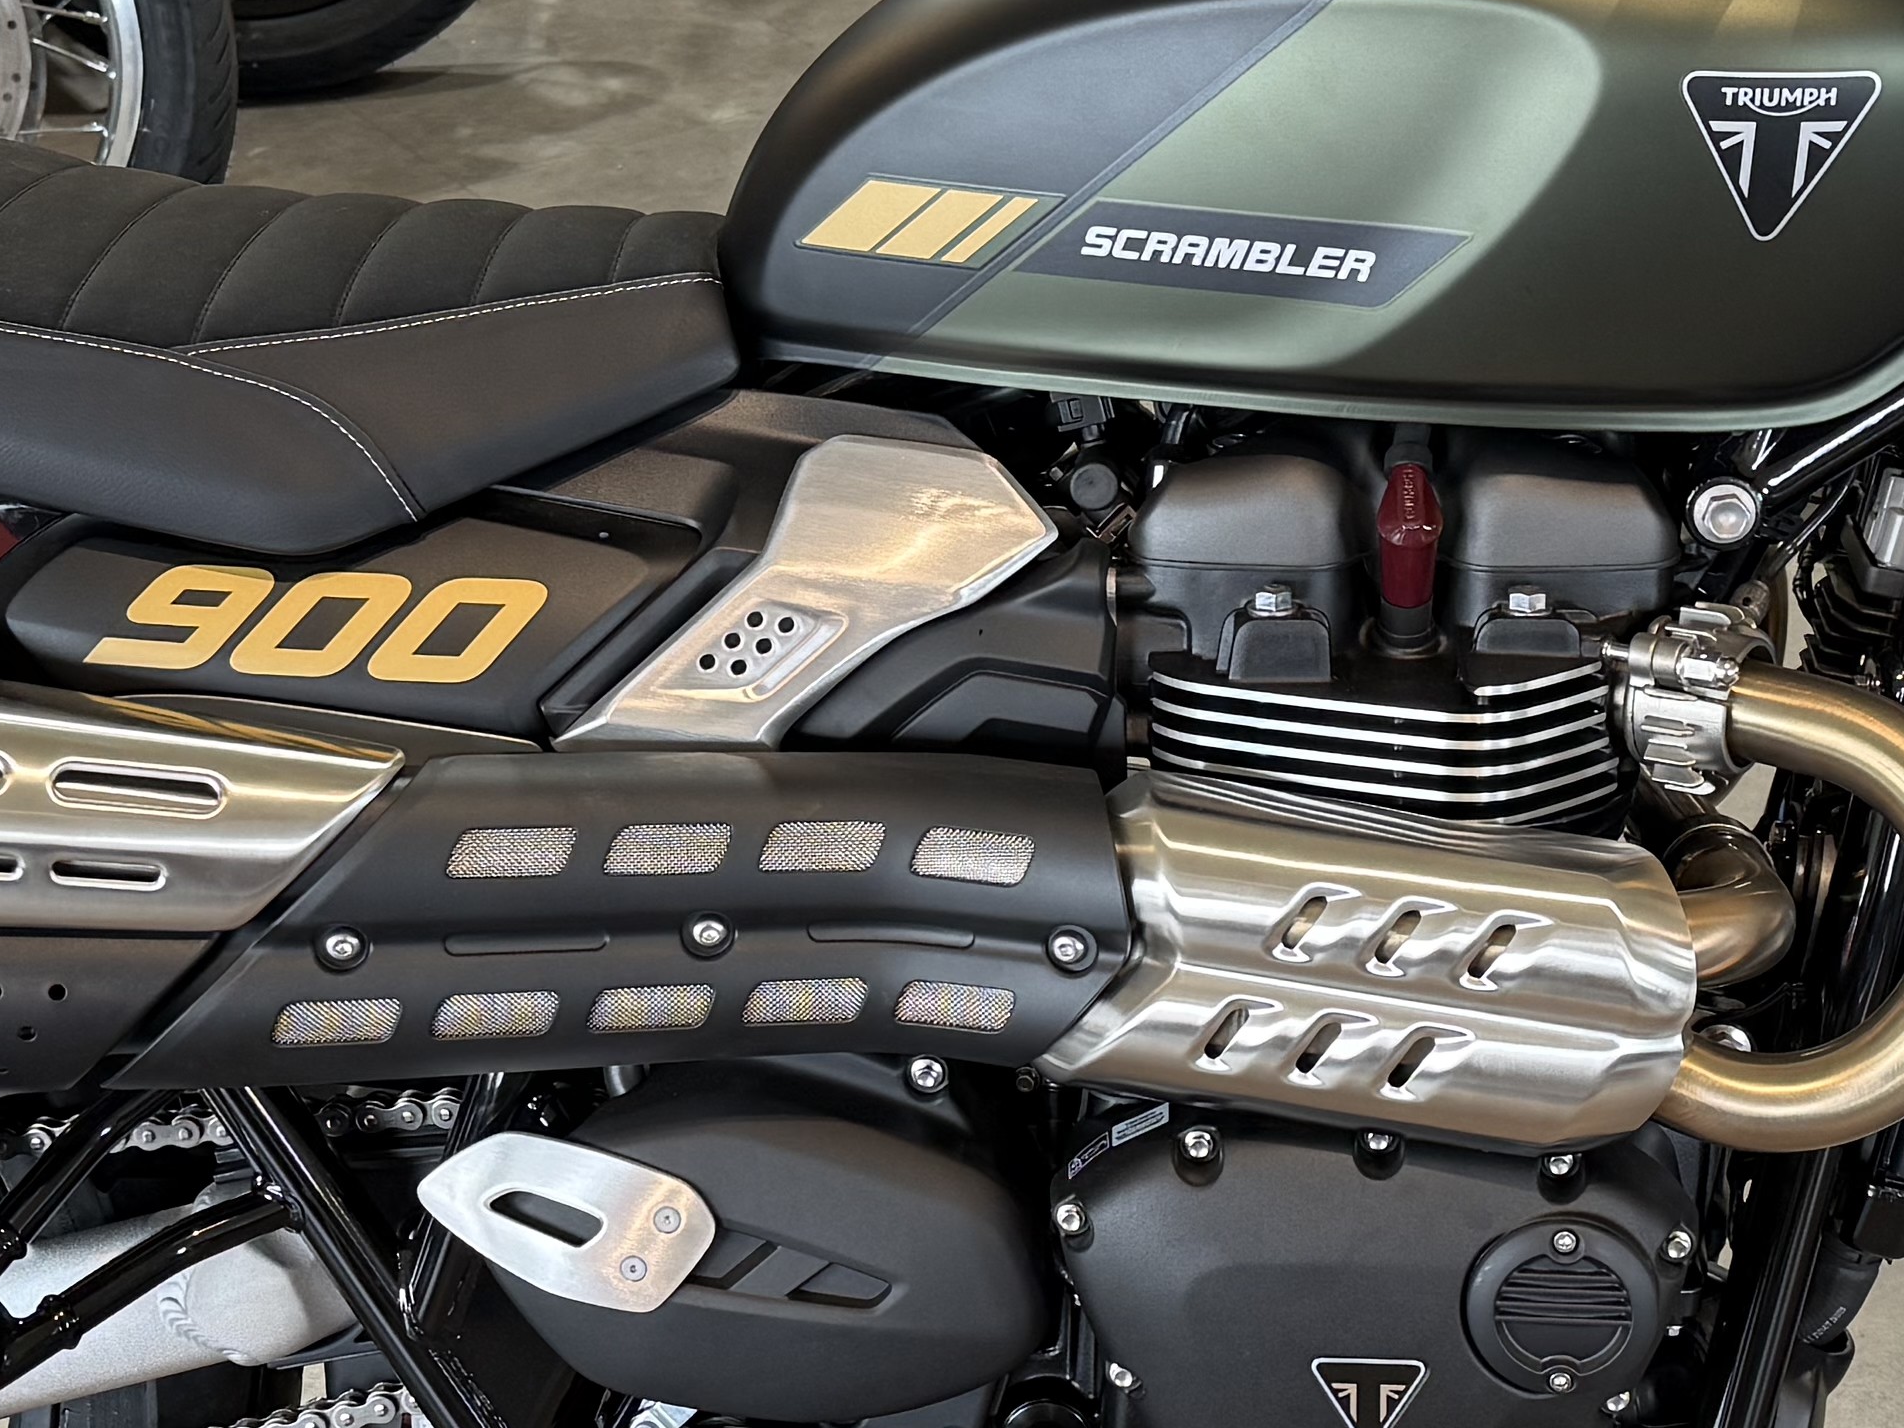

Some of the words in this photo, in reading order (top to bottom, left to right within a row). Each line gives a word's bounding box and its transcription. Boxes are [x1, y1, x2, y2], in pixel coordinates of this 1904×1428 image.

[1722, 86, 1838, 116] TRIUMPH
[1081, 225, 1376, 284] SCRAMBLER
[83, 564, 548, 683] 900
